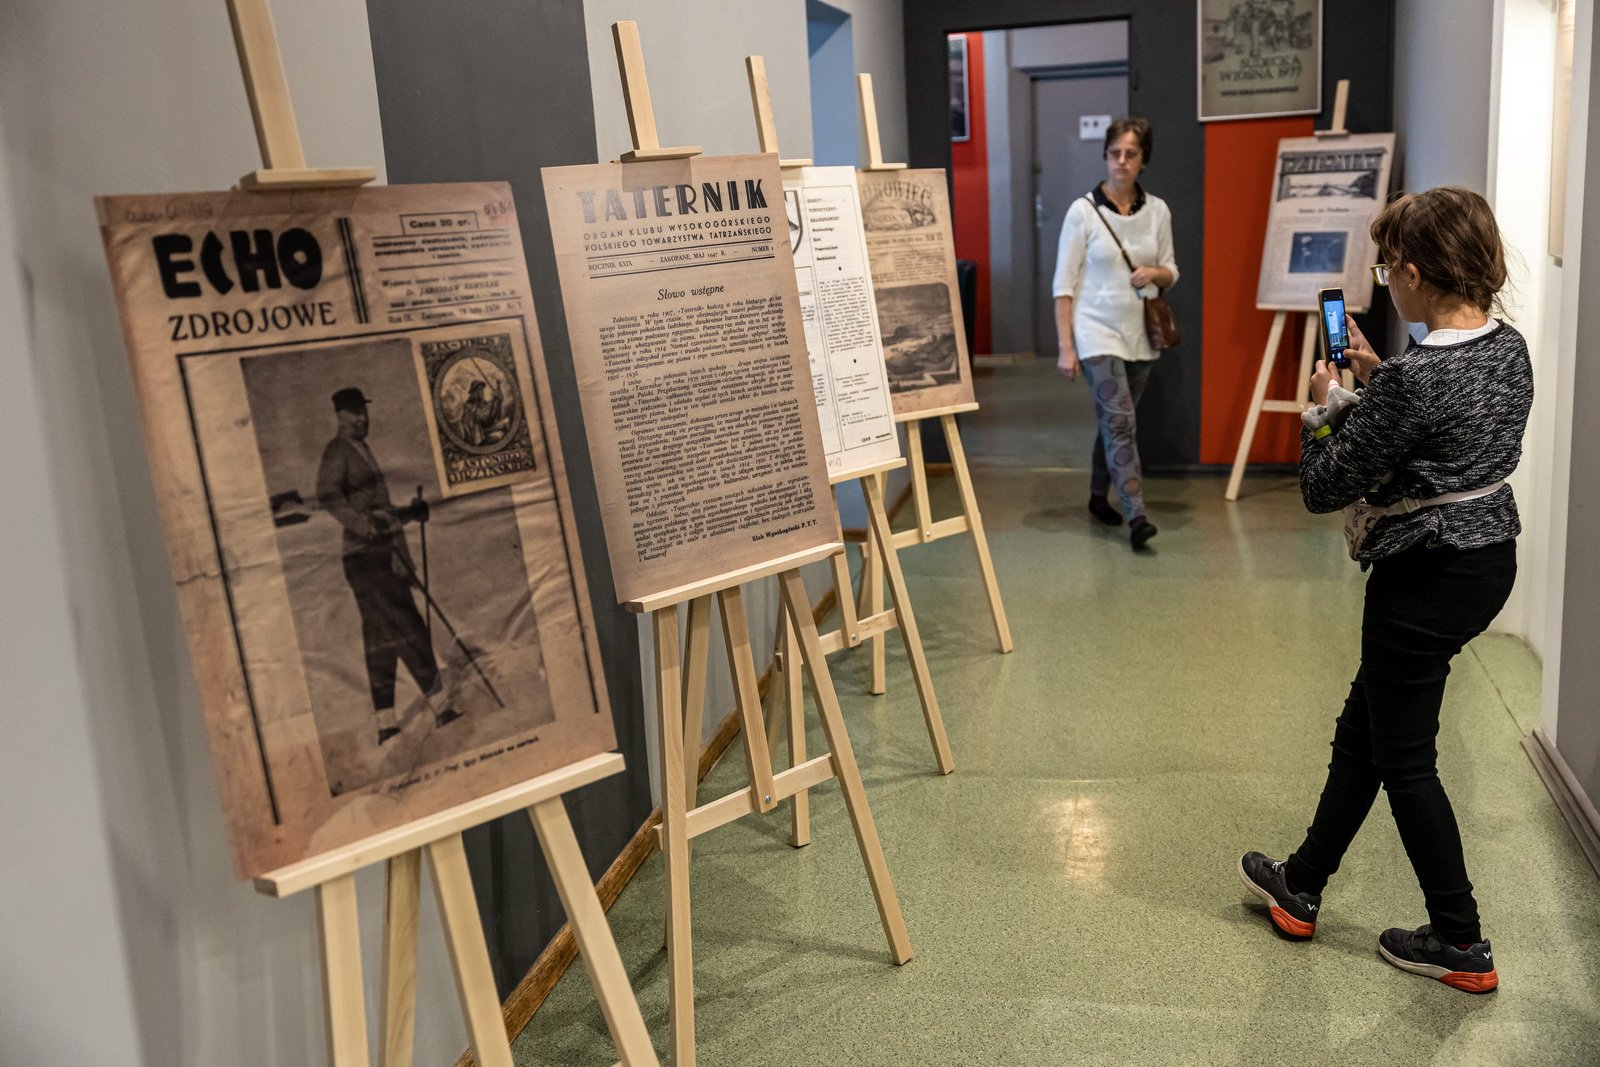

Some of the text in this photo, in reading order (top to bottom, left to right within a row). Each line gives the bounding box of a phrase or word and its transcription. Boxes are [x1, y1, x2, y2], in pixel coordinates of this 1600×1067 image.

[576, 178, 768, 224] TATERNIK
[409, 220, 436, 229] Cena
[440, 219, 452, 227] 20
[584, 216, 771, 240] ORGAN KLUBU WYSOKOGÓRSKIEGO
[585, 226, 772, 252] POLSKIEGO TOWARZYSTWA TATRZAŃSKIEGO
[152, 226, 323, 300] ECHO
[588, 262, 616, 271] ROCZNIK
[660, 254, 692, 263] ZAKOPANE,
[694, 252, 705, 260] MAJ
[657, 284, 724, 301] Słowo wstępne
[168, 301, 338, 341] ZDROJOWE
